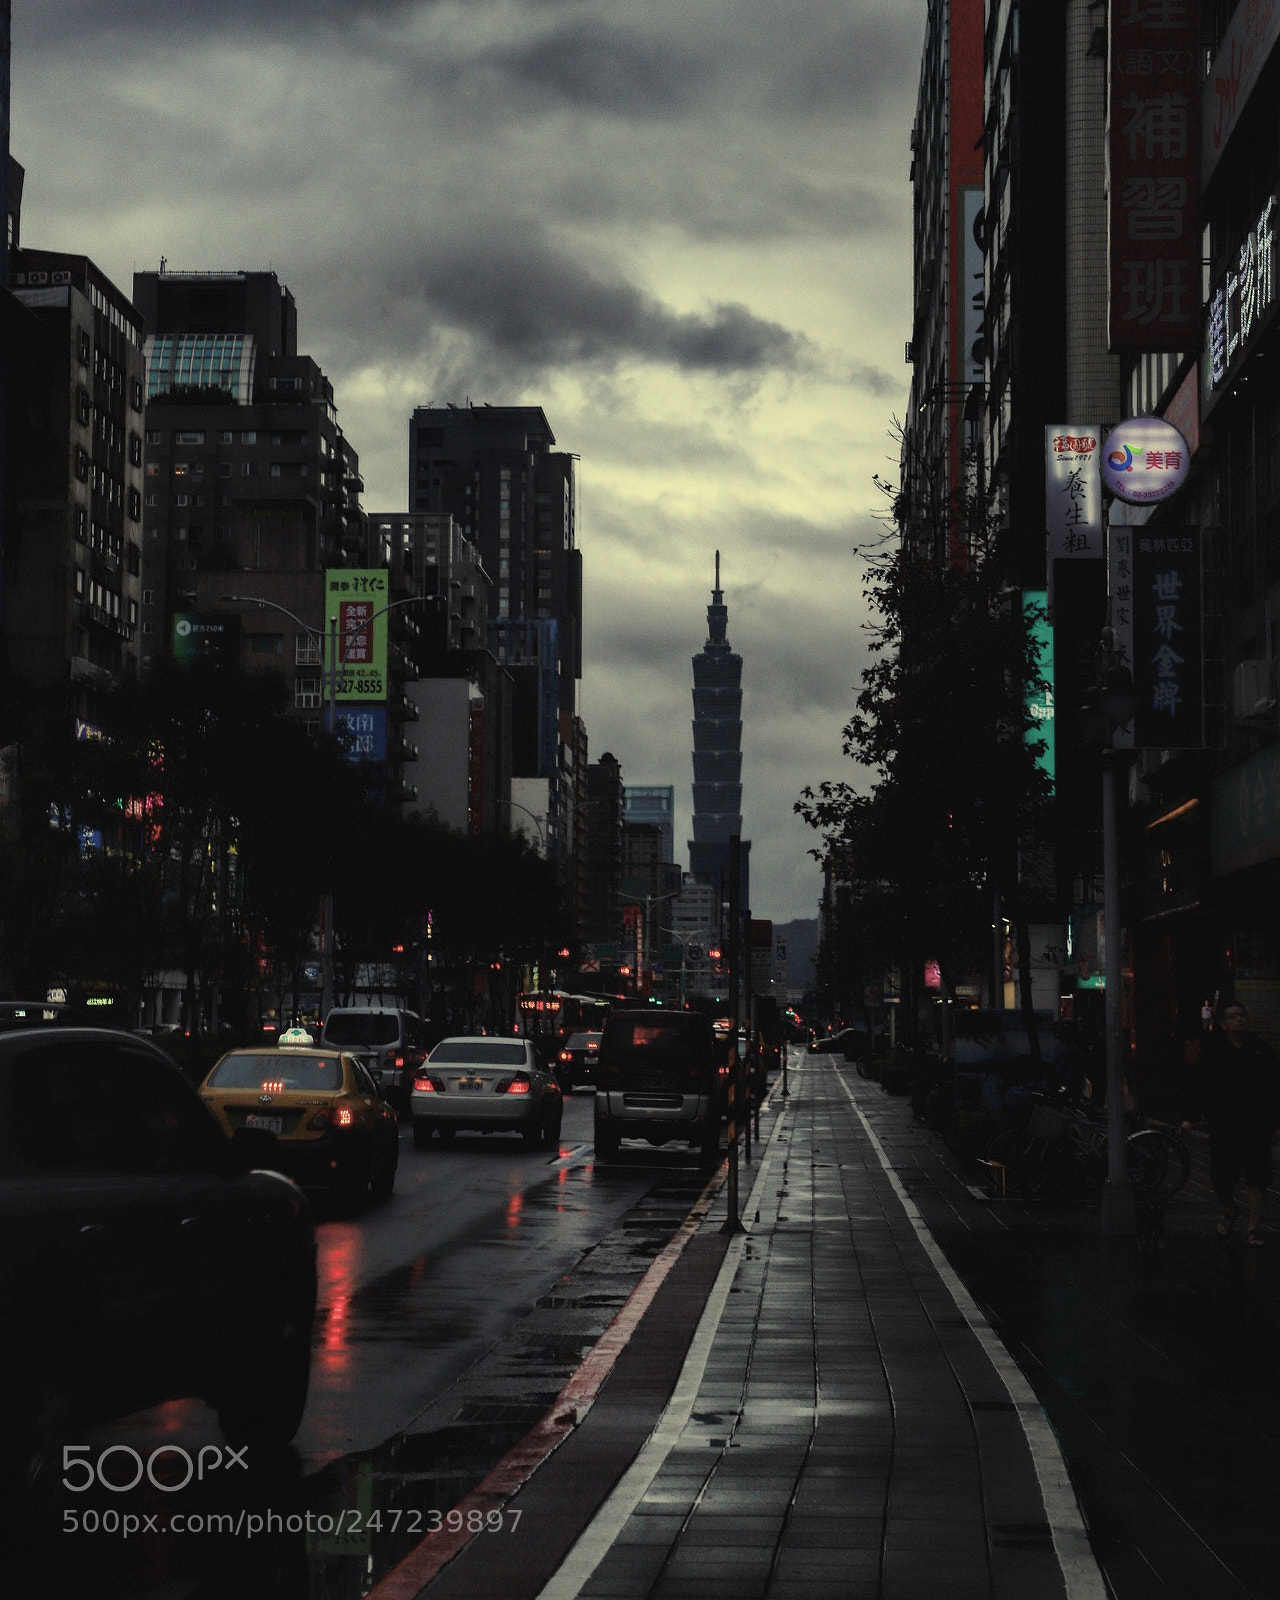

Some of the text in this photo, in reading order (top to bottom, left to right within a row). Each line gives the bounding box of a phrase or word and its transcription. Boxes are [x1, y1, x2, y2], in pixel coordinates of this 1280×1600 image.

[1146, 451, 1182, 470] 美育
[1151, 568, 1185, 717] 世界金牌
